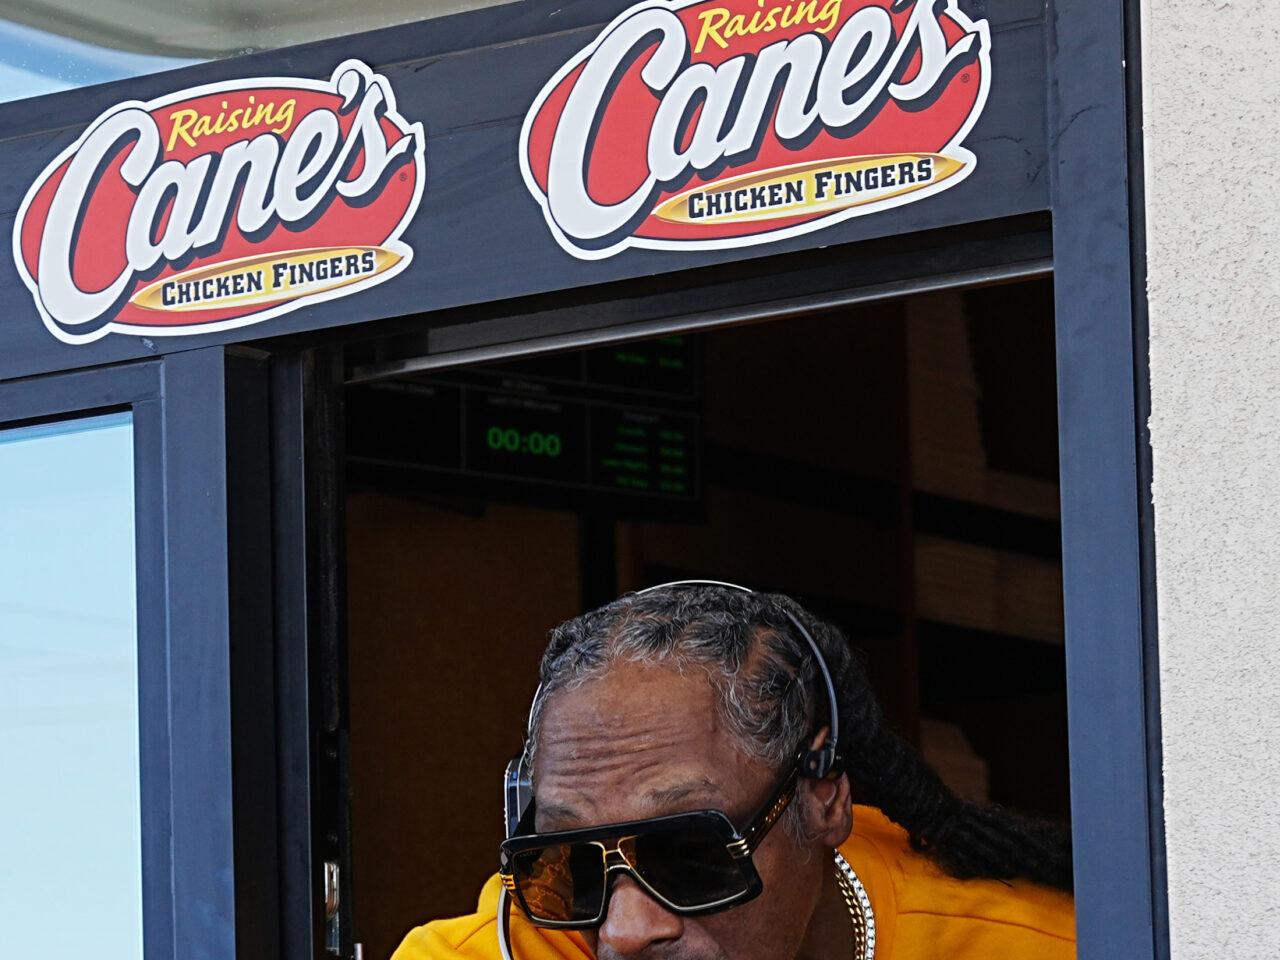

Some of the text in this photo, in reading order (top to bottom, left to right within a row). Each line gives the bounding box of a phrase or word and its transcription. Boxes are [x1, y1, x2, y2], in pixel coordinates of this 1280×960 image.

[694, 0, 841, 54] Raising
[166, 95, 296, 152] Raising
[548, 0, 976, 239] Canes
[38, 70, 414, 325] Cane's
[688, 158, 933, 219] CHICKEN FINGERS
[162, 251, 375, 307] CHICKEN FINGERS
[486, 426, 562, 457] 00:00
